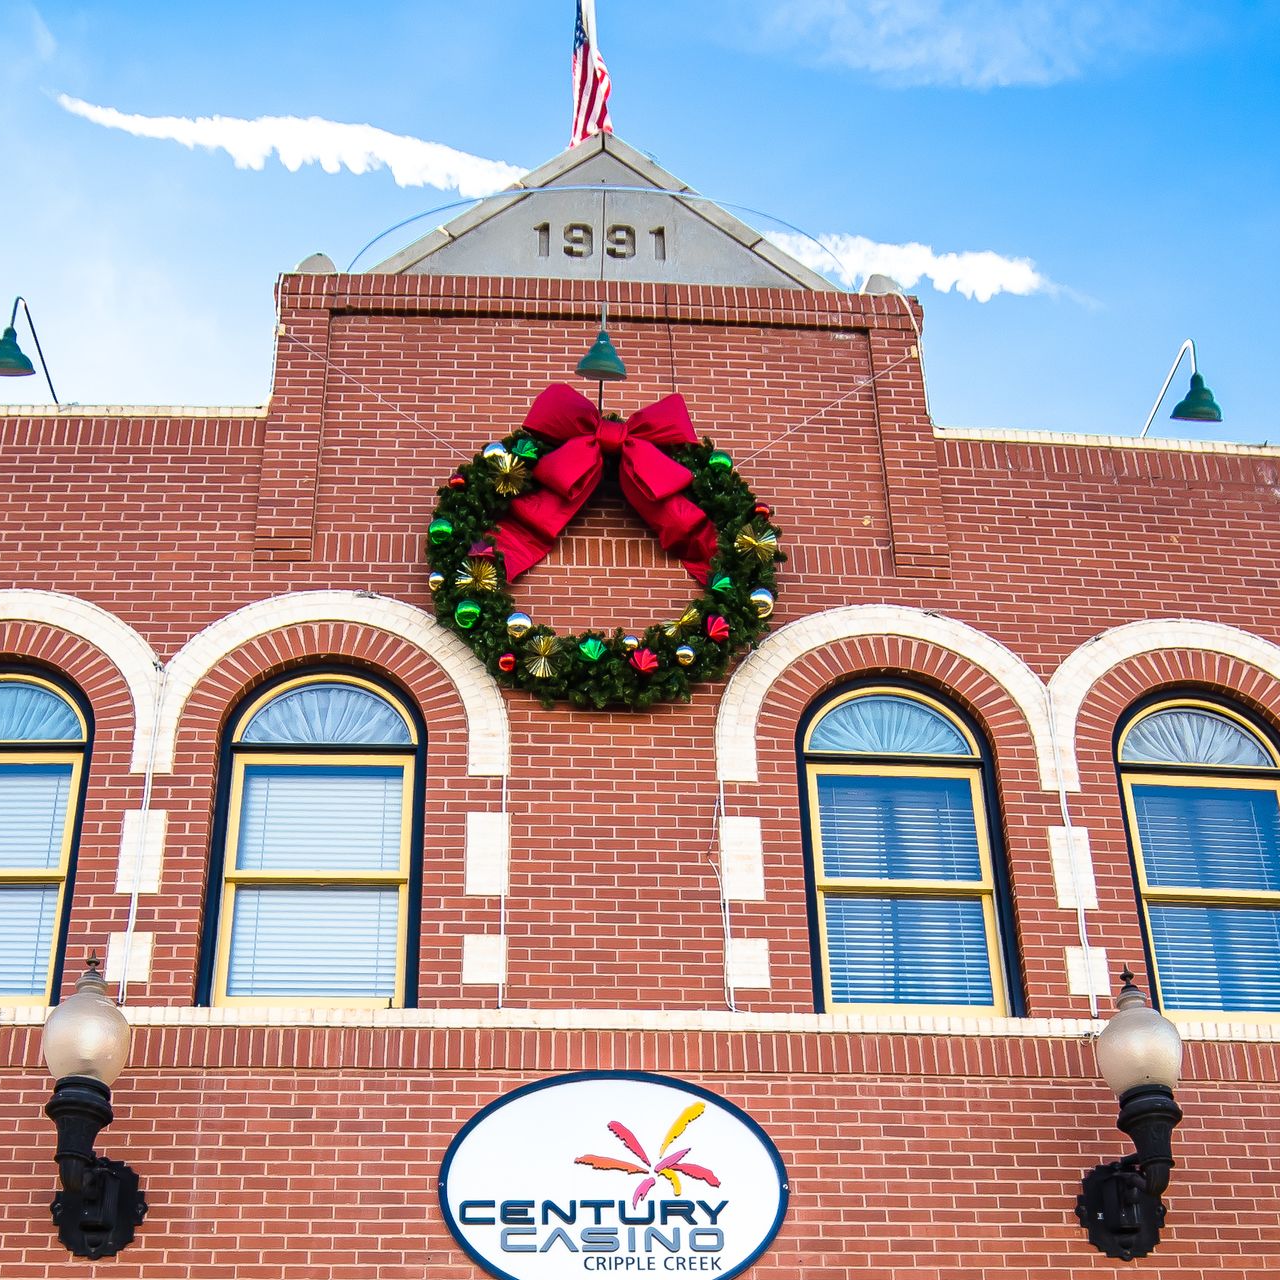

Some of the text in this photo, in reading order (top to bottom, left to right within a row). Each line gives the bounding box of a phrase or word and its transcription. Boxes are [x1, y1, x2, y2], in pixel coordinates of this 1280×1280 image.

[533, 221, 666, 261] 1991
[458, 1199, 730, 1226] CENTURY
[499, 1226, 726, 1254] CASINO
[583, 1255, 722, 1272] CRIPPLE CREEK
